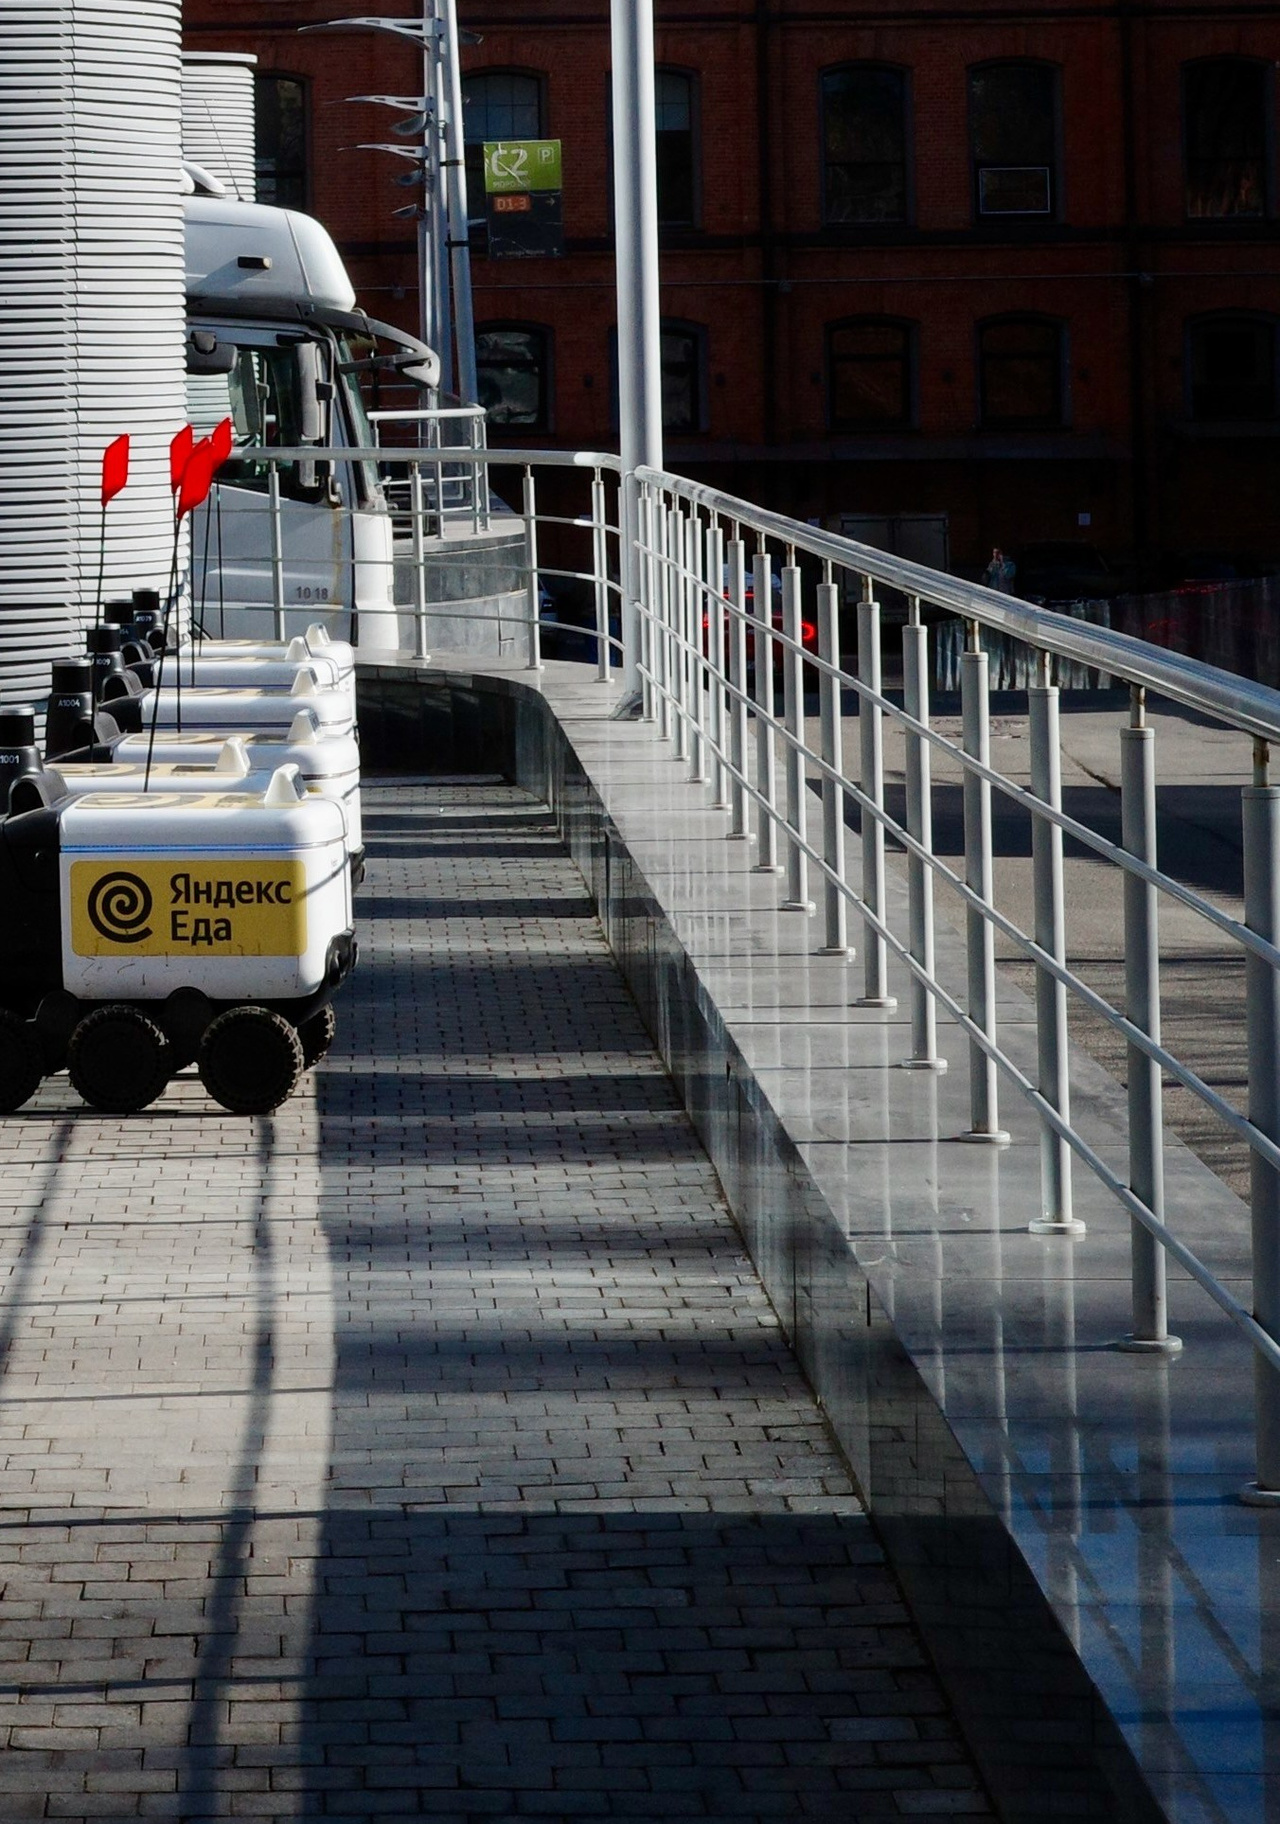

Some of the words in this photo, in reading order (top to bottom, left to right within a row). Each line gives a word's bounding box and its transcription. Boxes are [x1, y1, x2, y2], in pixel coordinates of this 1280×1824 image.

[541, 149, 551, 162] P
[170, 873, 292, 908] Яндекс
[170, 910, 232, 946] Еда
